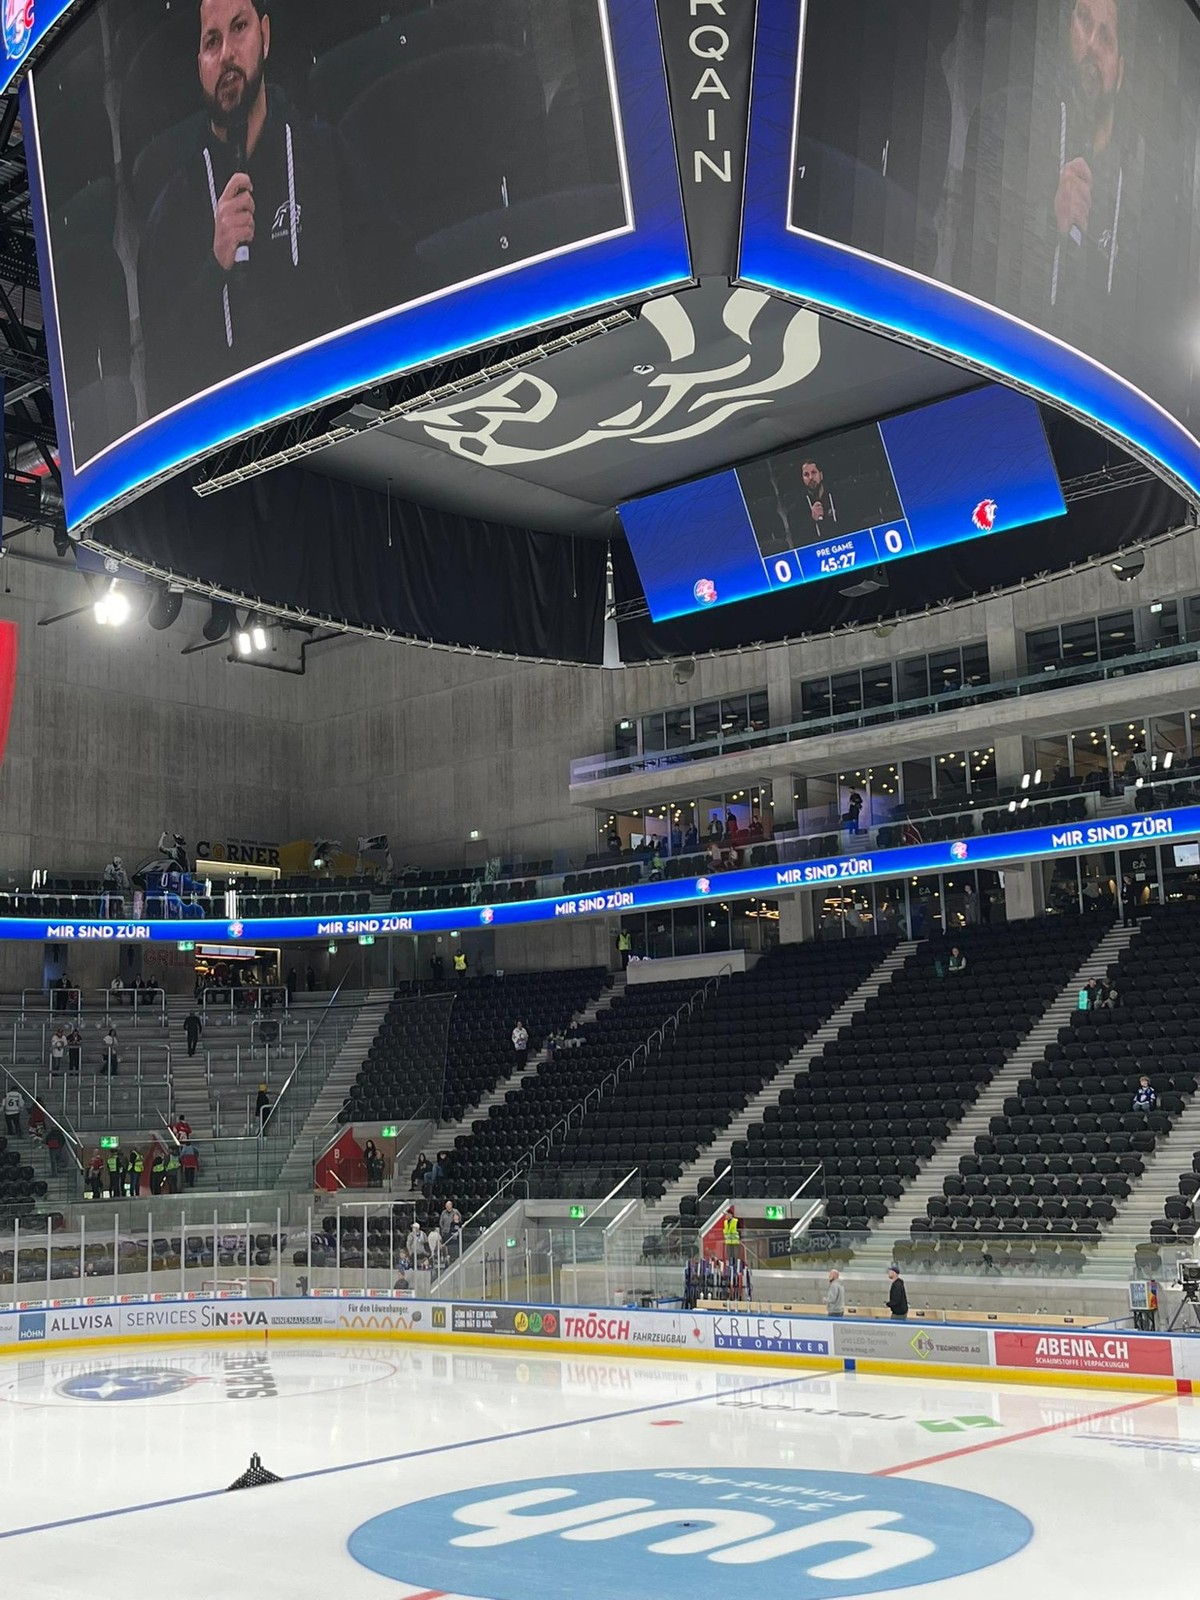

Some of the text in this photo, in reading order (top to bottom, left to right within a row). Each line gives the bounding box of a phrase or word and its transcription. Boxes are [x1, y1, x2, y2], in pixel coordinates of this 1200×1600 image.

[500, 236, 509, 249] 3
[816, 541, 854, 557] PRE GAME
[884, 530, 903, 553] 0
[775, 560, 791, 582] 0
[821, 552, 856, 572] 45:27
[1052, 817, 1172, 848] MIR SIND ZÜRI
[197, 841, 279, 865] CORNER
[777, 858, 872, 884] MIR SIND ZÜRI
[555, 892, 634, 915] MIR SIND ZÜRI
[47, 923, 150, 938] MIR SIND ZÜRI
[318, 916, 412, 934] MIR SIND ZÜRI
[348, 1304, 357, 1312] Für
[359, 1304, 370, 1312] den
[51, 1315, 113, 1332] ALLVISA
[127, 1310, 196, 1327] SERVICES
[271, 1317, 322, 1325] INNENAUSBAU
[564, 1312, 630, 1340] TRÖSCH
[713, 1317, 793, 1340] KRIESI
[633, 1332, 687, 1344] FAHRZEUGBAU
[718, 1337, 824, 1352] DIE OPTIKER
[1035, 1337, 1129, 1359] ABENA.CH
[1035, 1357, 1129, 1369] SCHAUMSTOFFE VERPACKUNGEN
[716, 1400, 906, 1421] netvoip
[654, 1471, 866, 1502] Finanz-App
[718, 1492, 835, 1511] 3-in-1
[449, 1487, 936, 1580] yuh
